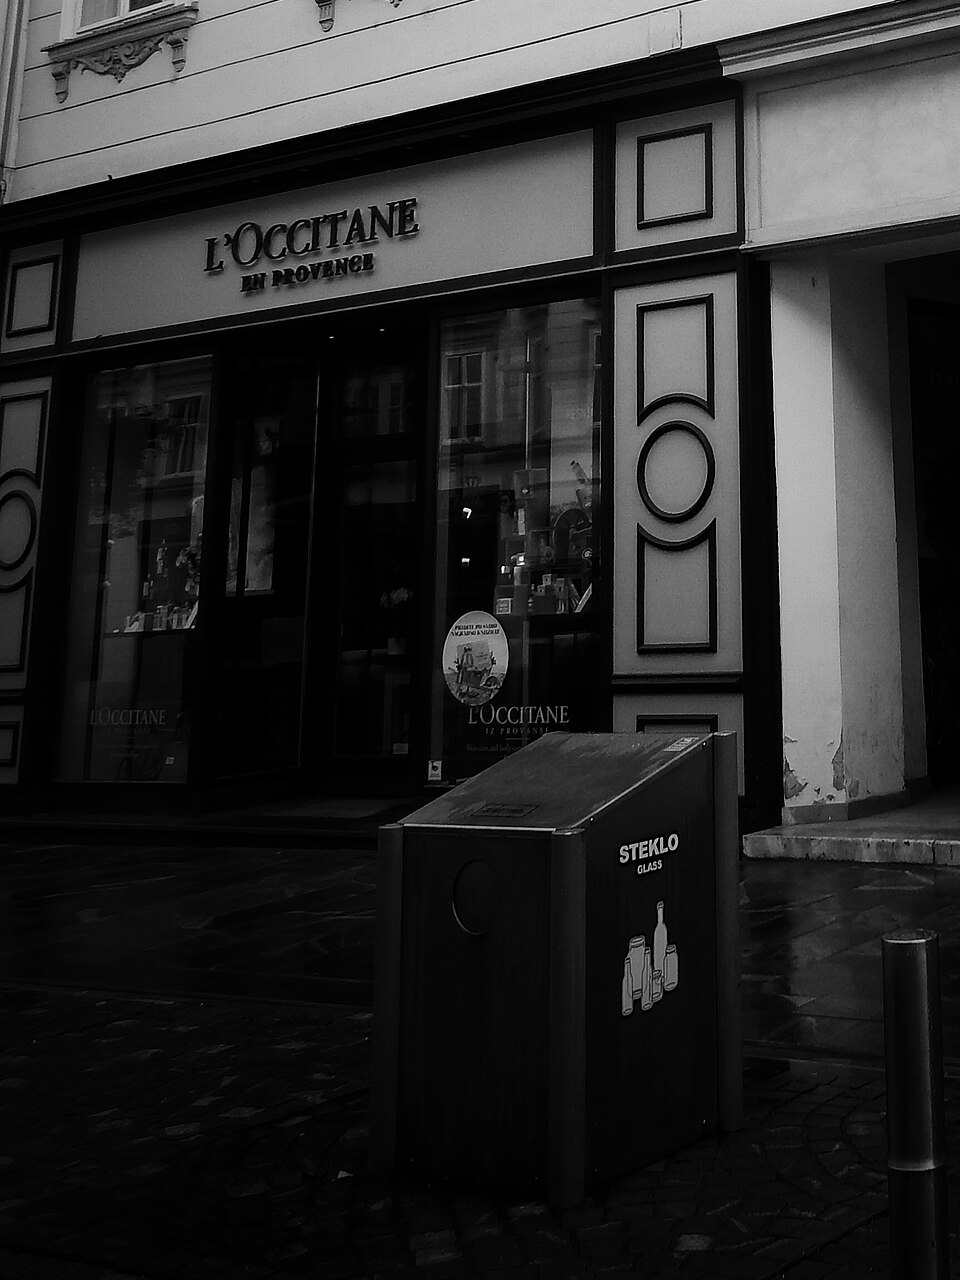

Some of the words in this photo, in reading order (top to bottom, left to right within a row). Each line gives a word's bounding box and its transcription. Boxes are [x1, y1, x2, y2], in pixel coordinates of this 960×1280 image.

[240, 273, 266, 292] EN
[271, 253, 375, 287] PROVENCE
[619, 833, 679, 864] STEKLO
[637, 859, 663, 875] GLASS
